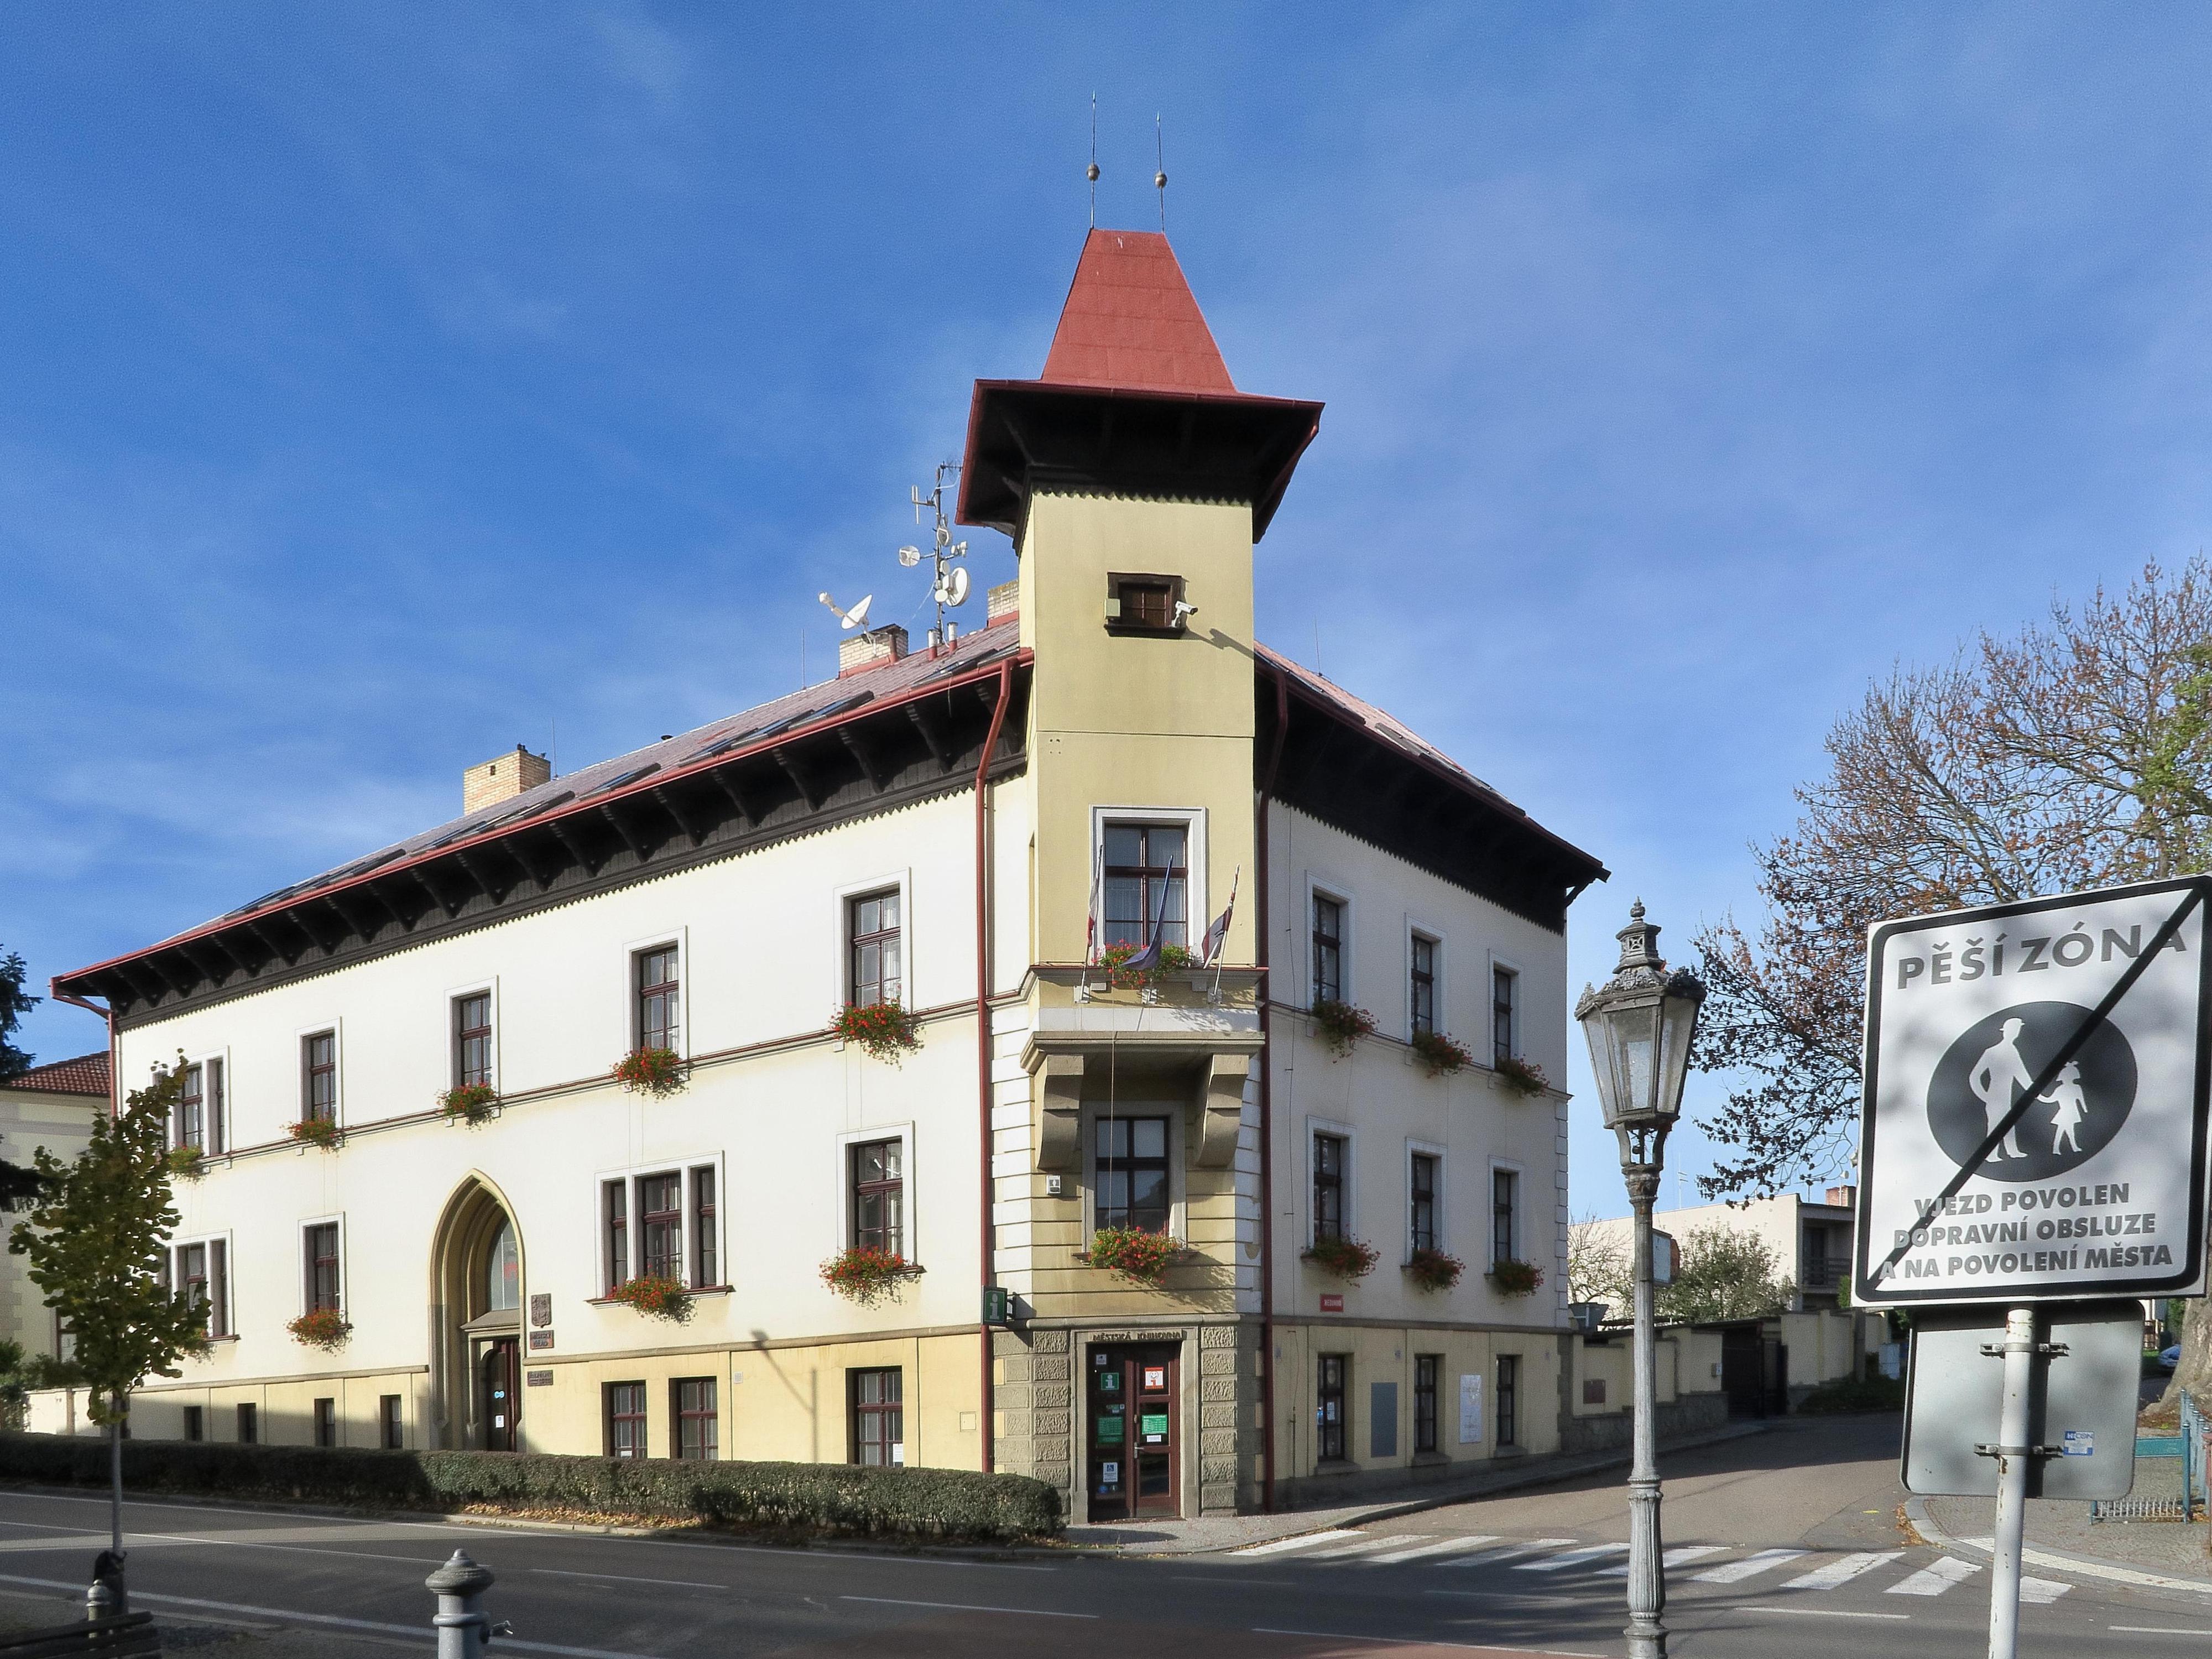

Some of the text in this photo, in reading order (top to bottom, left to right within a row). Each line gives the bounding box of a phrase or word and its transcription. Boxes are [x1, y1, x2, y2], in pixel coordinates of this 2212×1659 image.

[1897, 933, 2008, 989] PĚŠÍ
[1914, 1183, 2129, 1218] VJEZD POVOLEN
[1894, 1213, 2155, 1249] DOPRAVNÍ OBSLUZE
[1879, 1241, 2173, 1280] A NA POVOLENÍ MĚSTA
